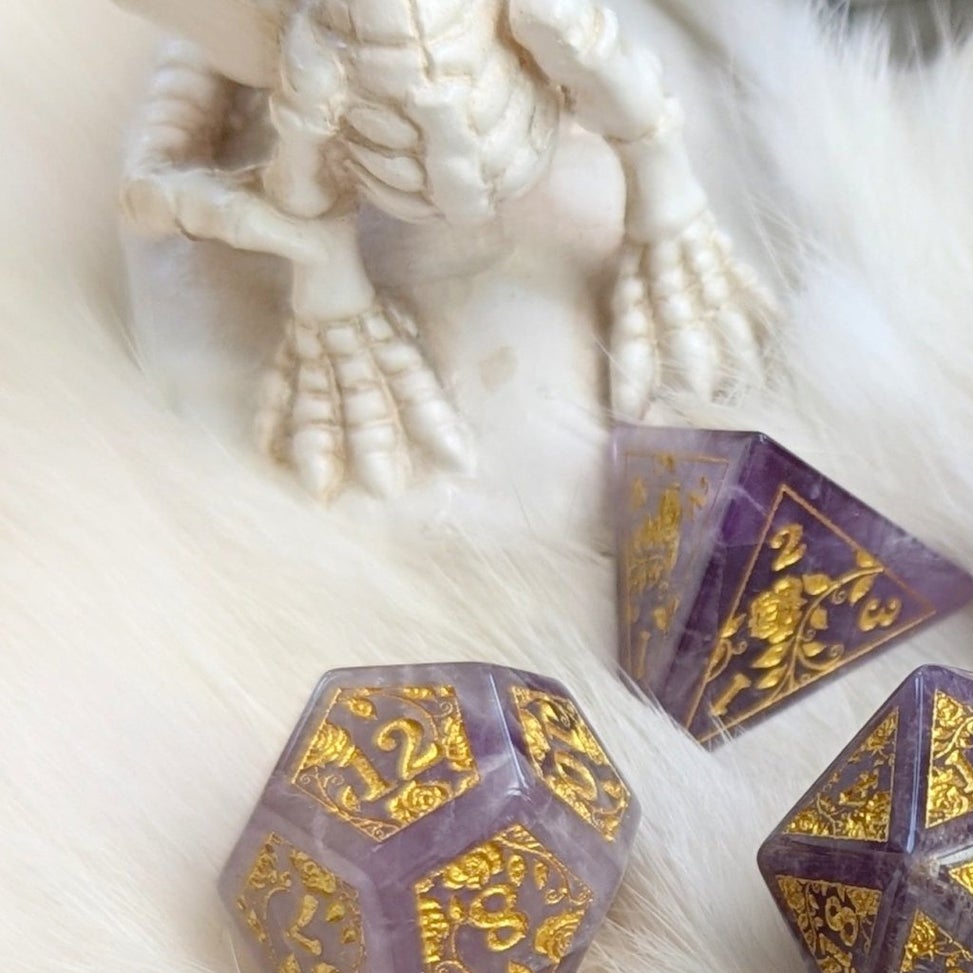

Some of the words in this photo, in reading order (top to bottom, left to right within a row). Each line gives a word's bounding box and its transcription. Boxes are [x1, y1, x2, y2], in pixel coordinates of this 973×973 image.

[770, 523, 806, 571] 2
[858, 599, 900, 632] 3
[711, 674, 751, 716] 1
[347, 718, 440, 802] 12
[541, 703, 598, 801] 10
[469, 884, 529, 951] 8
[820, 895, 858, 968] 18
